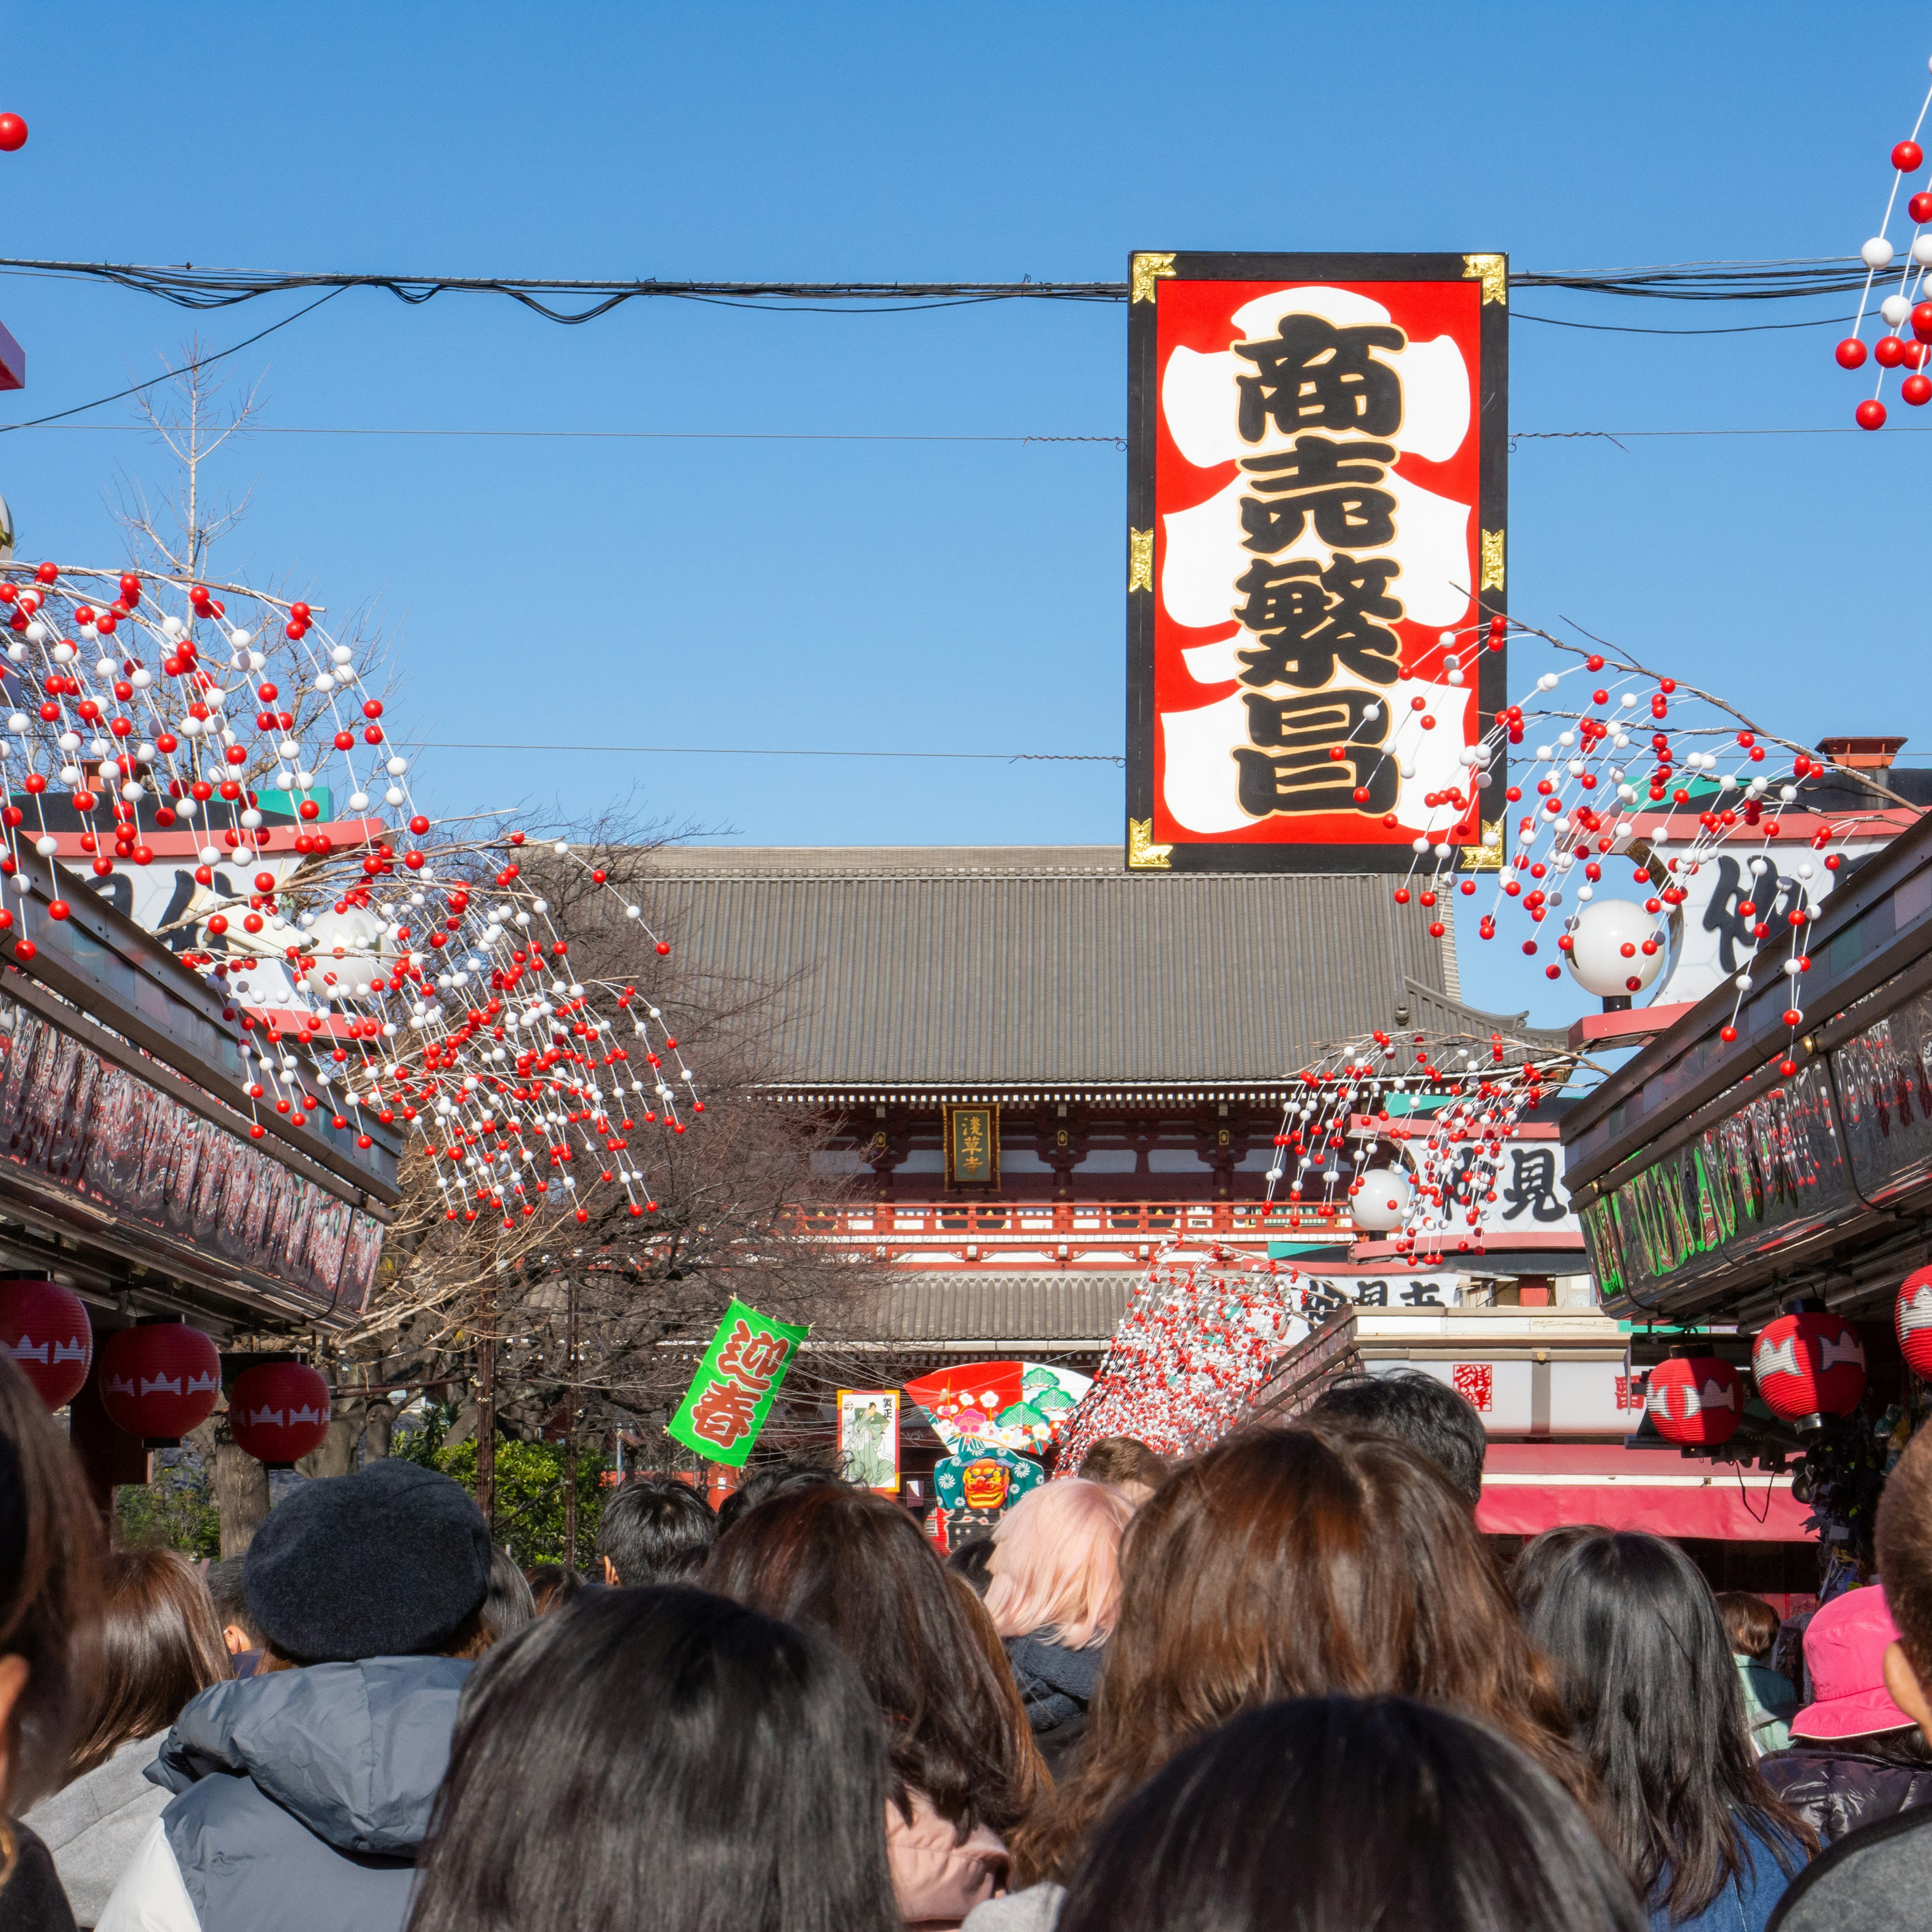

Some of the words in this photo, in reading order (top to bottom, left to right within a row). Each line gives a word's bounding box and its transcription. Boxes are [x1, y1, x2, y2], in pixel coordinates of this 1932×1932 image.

[1230, 311, 1408, 818] 商売繁昌
[691, 1319, 789, 1448] 迎春
[882, 1397, 893, 1419] 賀正
